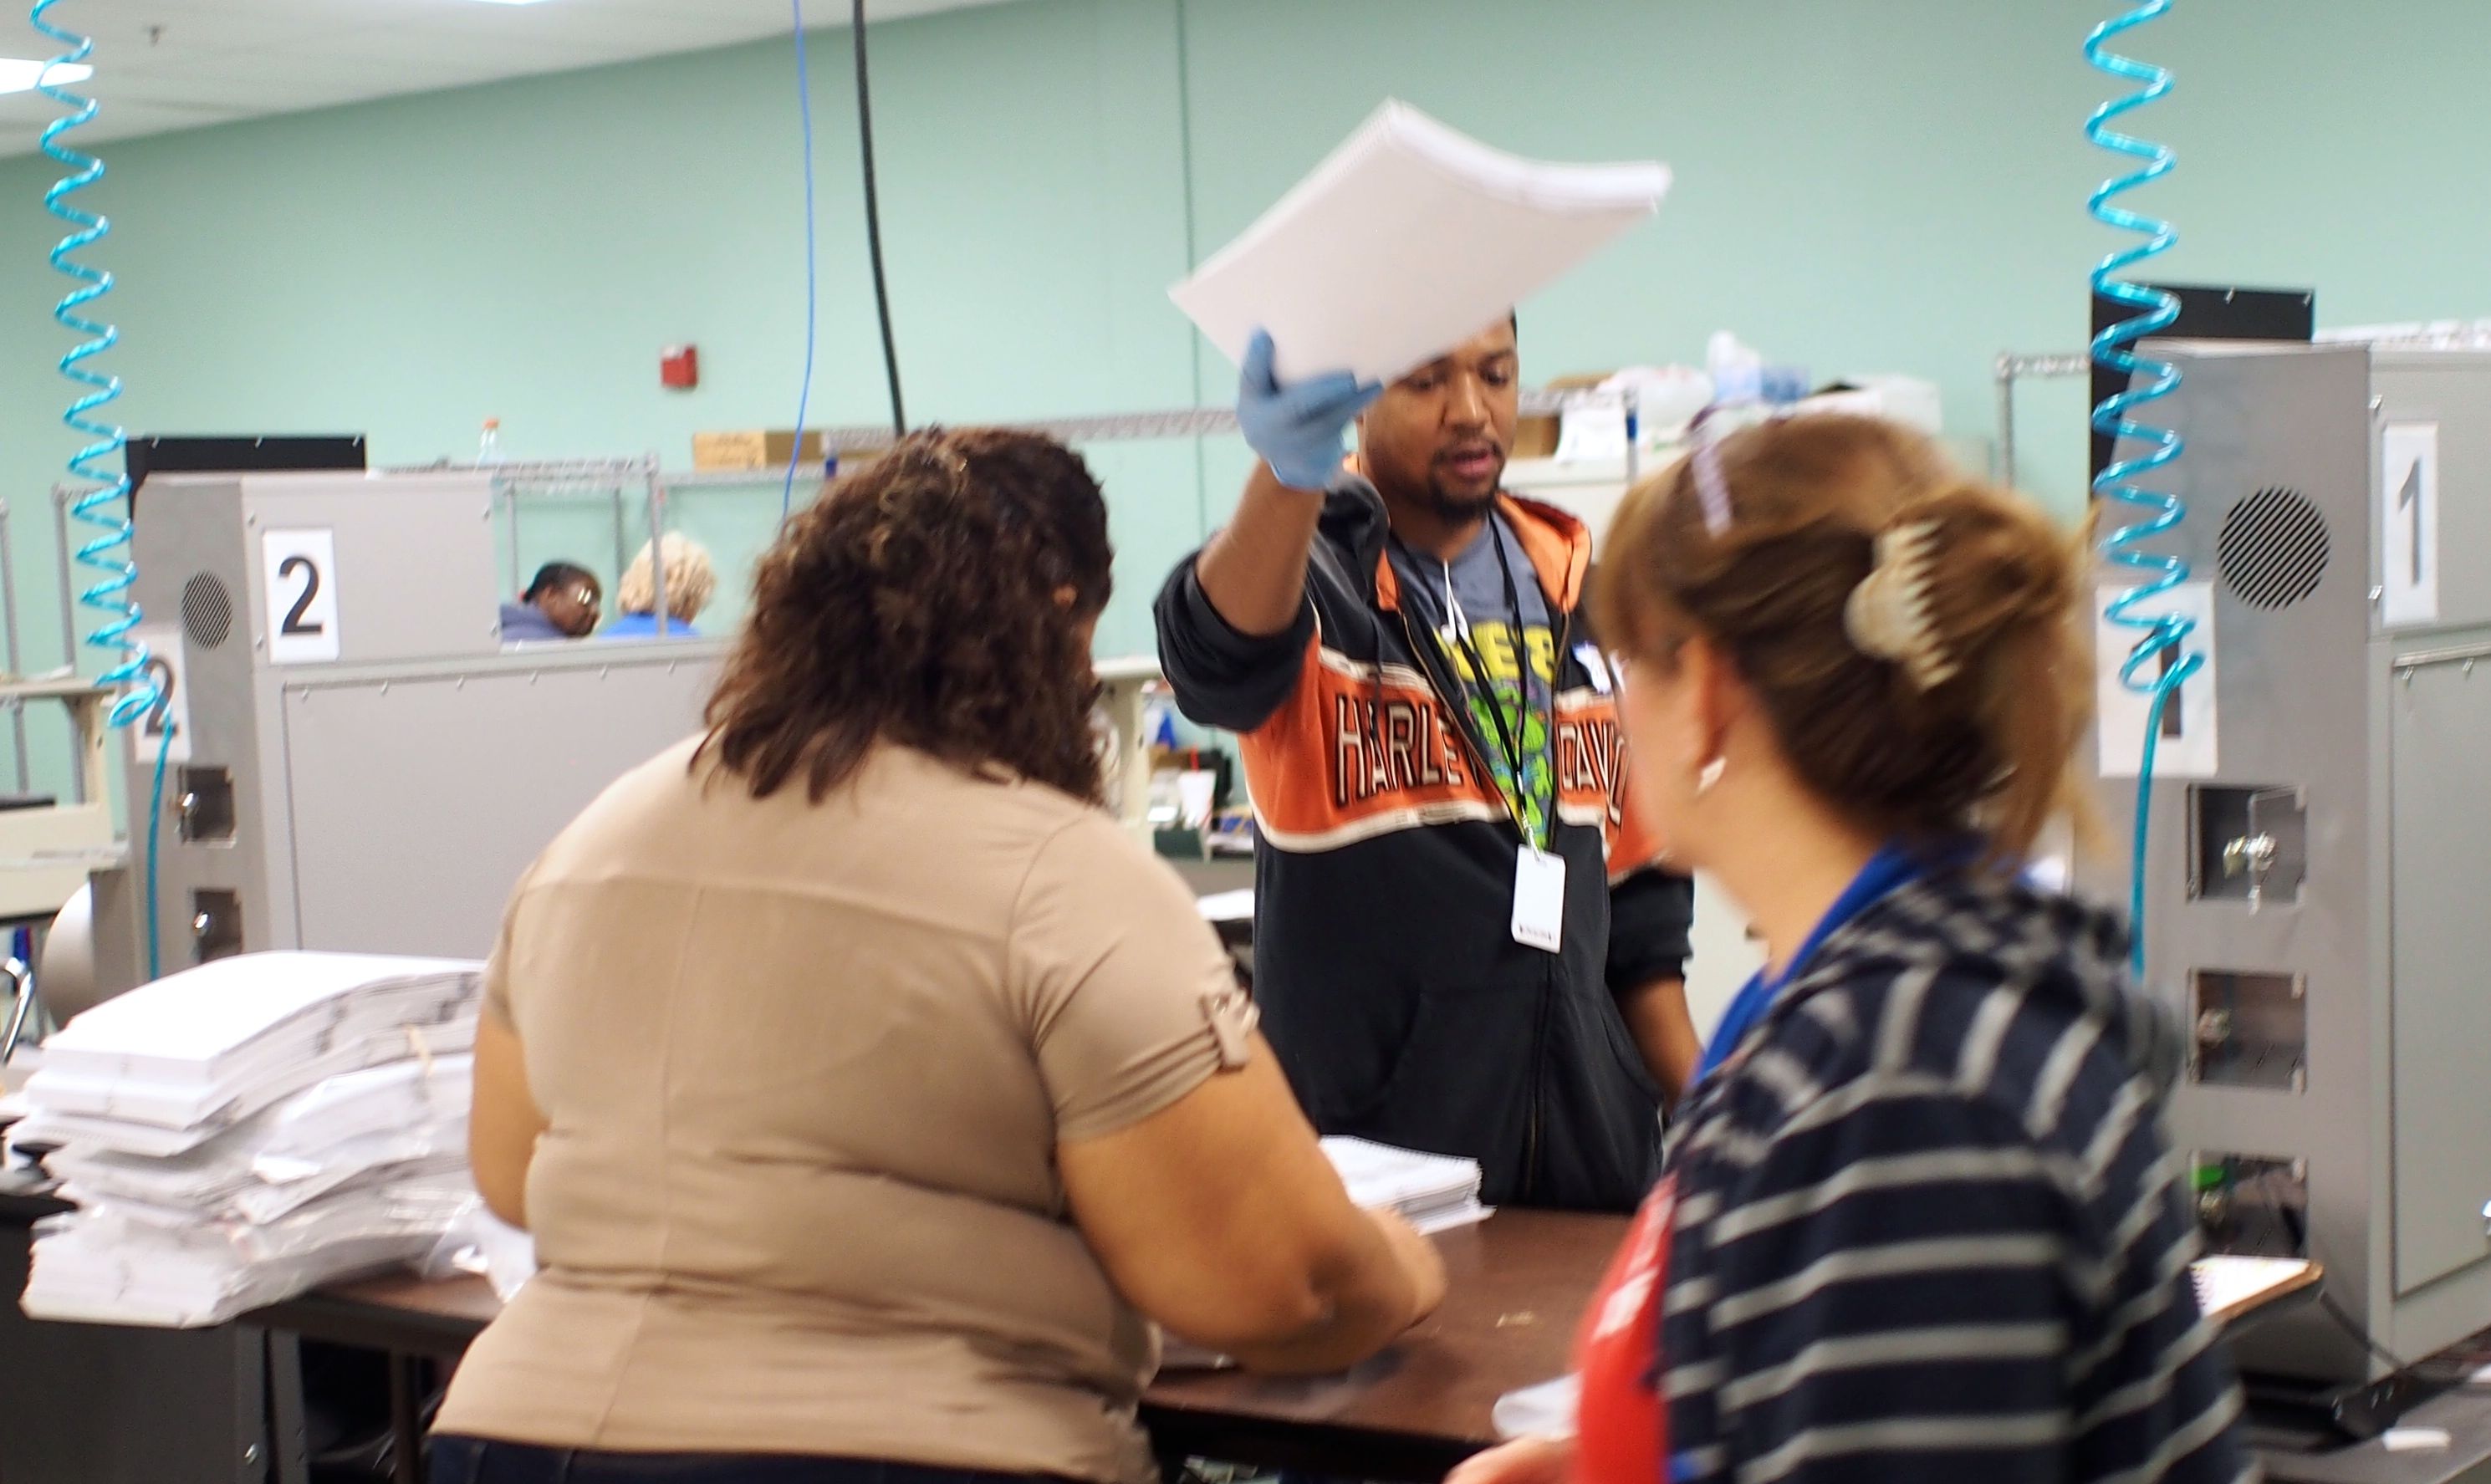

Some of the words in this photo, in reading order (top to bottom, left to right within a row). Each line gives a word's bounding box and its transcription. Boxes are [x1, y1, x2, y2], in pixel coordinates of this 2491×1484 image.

[2399, 456, 2422, 588] 1
[278, 555, 324, 636] 2
[143, 657, 179, 737] 2
[1335, 694, 1482, 806] HARLE
